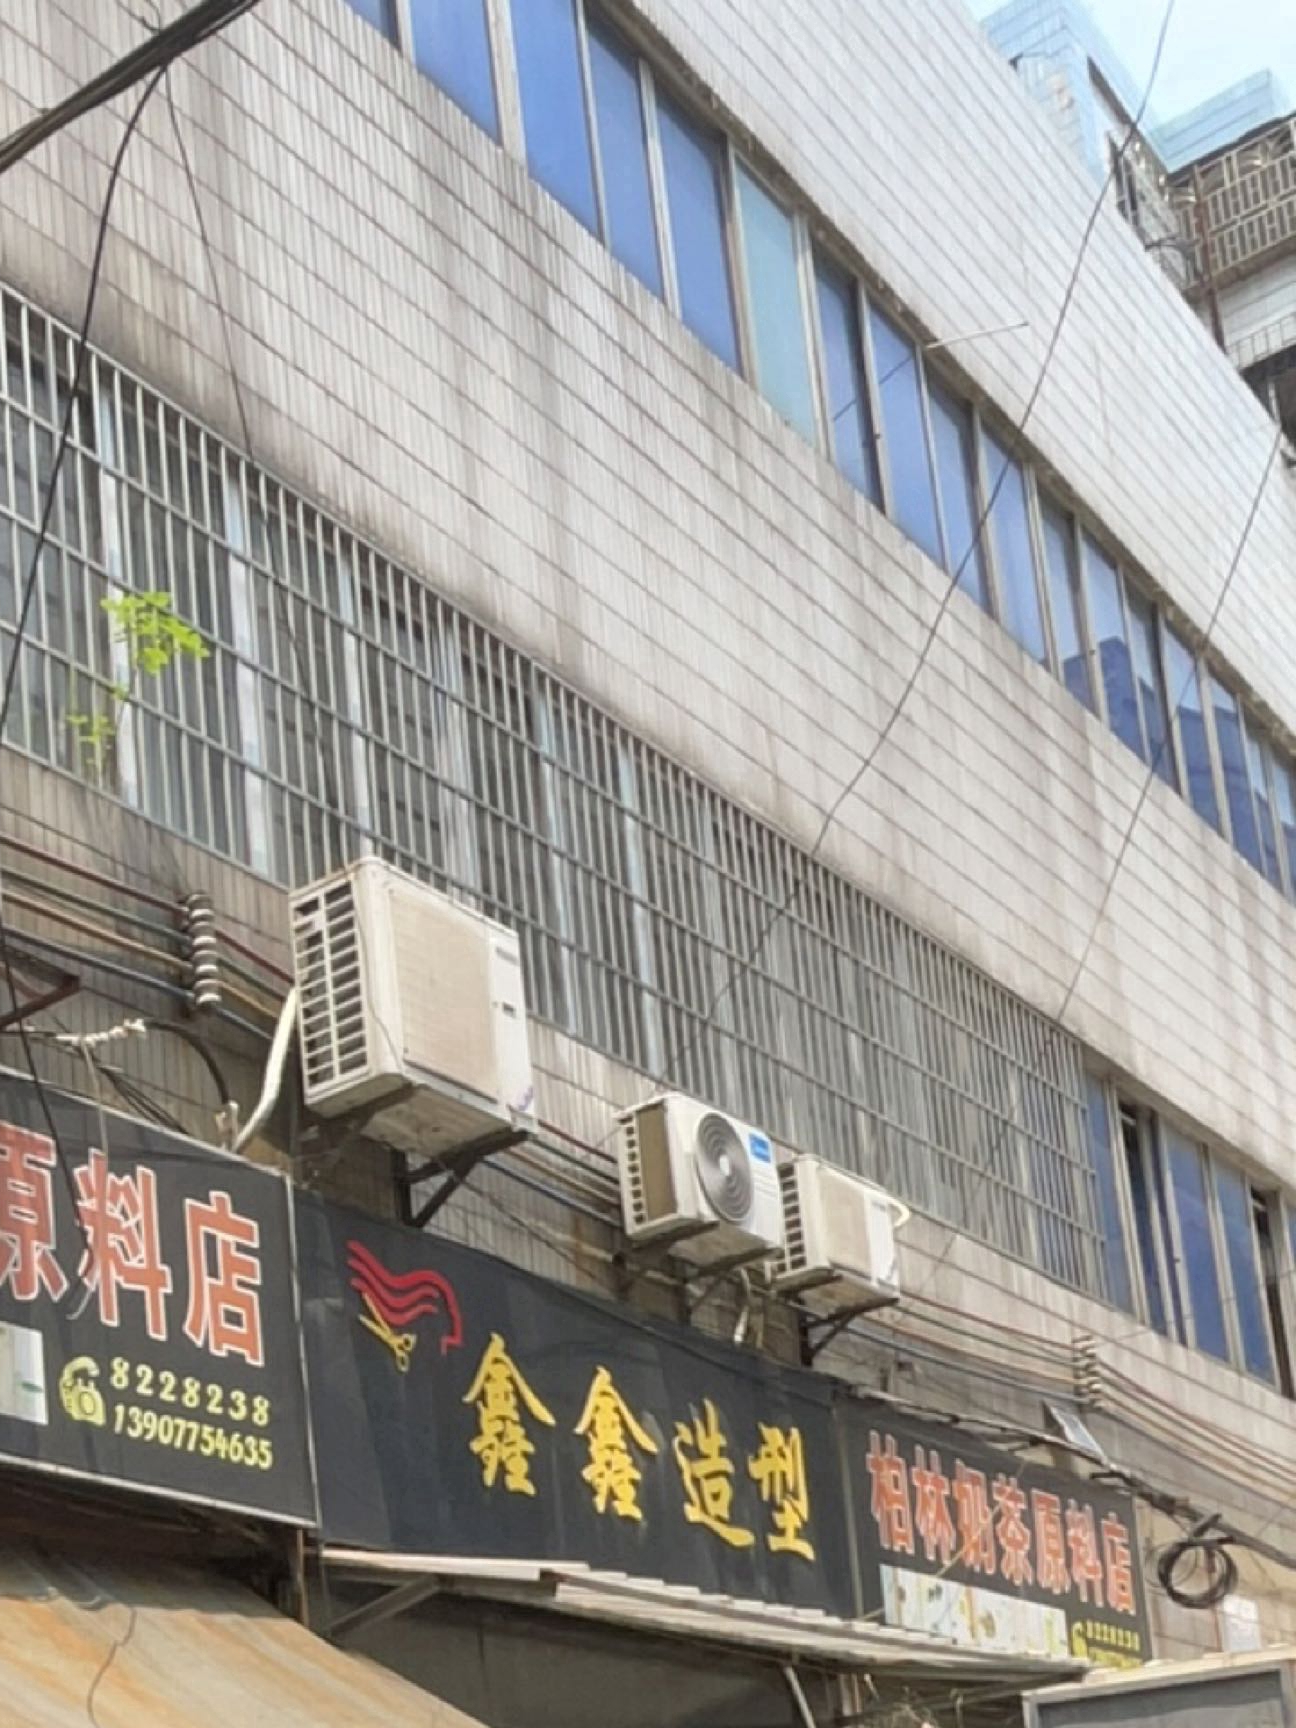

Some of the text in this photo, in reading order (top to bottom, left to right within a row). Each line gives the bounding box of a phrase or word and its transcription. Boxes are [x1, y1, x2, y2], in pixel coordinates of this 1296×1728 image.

[109, 1356, 271, 1427] 8228238
[462, 1332, 816, 1561] 鑫鑫造型
[865, 1430, 1137, 1615] 柏林奶茶原料店
